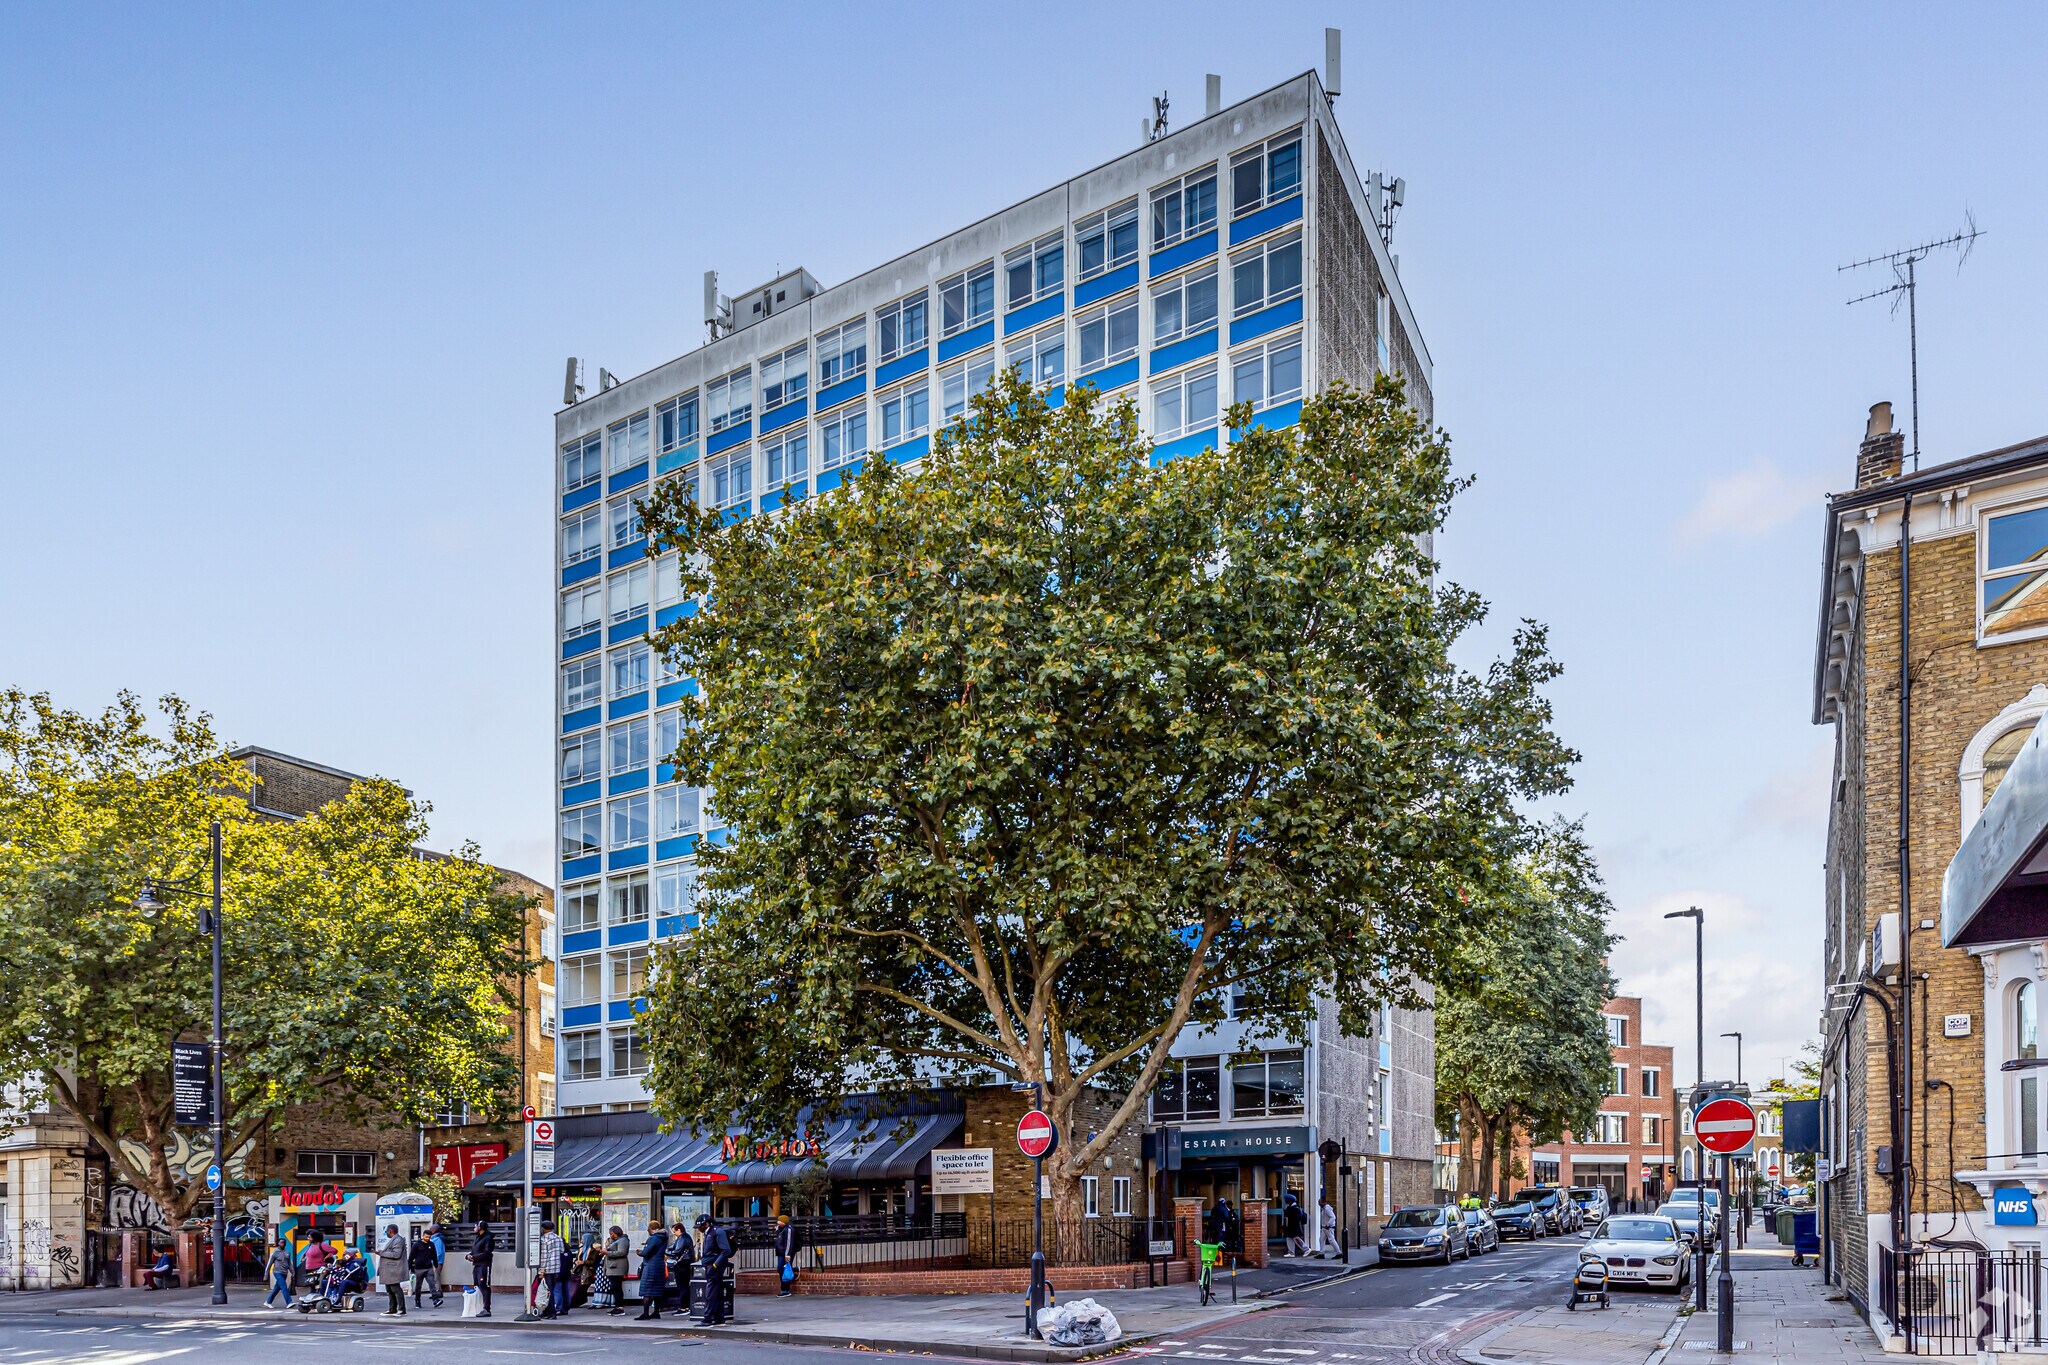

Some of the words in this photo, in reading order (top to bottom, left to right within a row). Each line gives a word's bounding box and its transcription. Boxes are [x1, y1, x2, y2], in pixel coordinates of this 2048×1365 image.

[526, 1107, 534, 1118] C
[1246, 1136, 1292, 1146] HOUSE
[279, 1184, 344, 1206] Nando's
[378, 1206, 395, 1215] Cash
[1998, 1201, 2028, 1212] NHS
